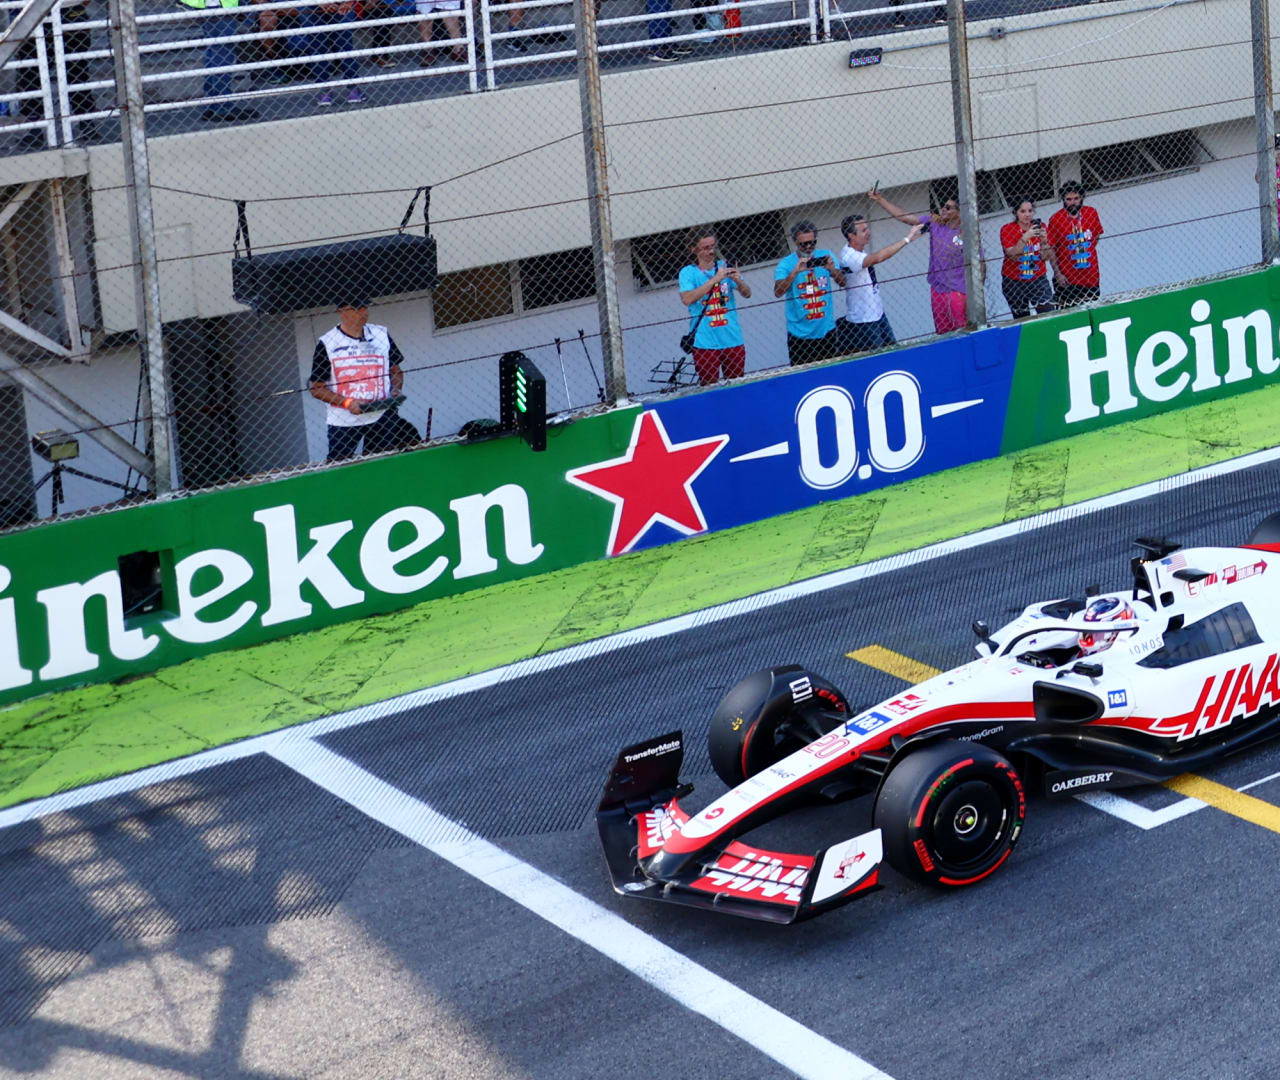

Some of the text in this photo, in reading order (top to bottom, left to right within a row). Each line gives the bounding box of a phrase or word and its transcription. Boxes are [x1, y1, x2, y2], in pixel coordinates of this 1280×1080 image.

[795, 369, 927, 490] 0.0
[1108, 691, 1127, 706] 1&1
[624, 739, 681, 764] TransferMate
[1051, 771, 1114, 794] OAKBERRY
